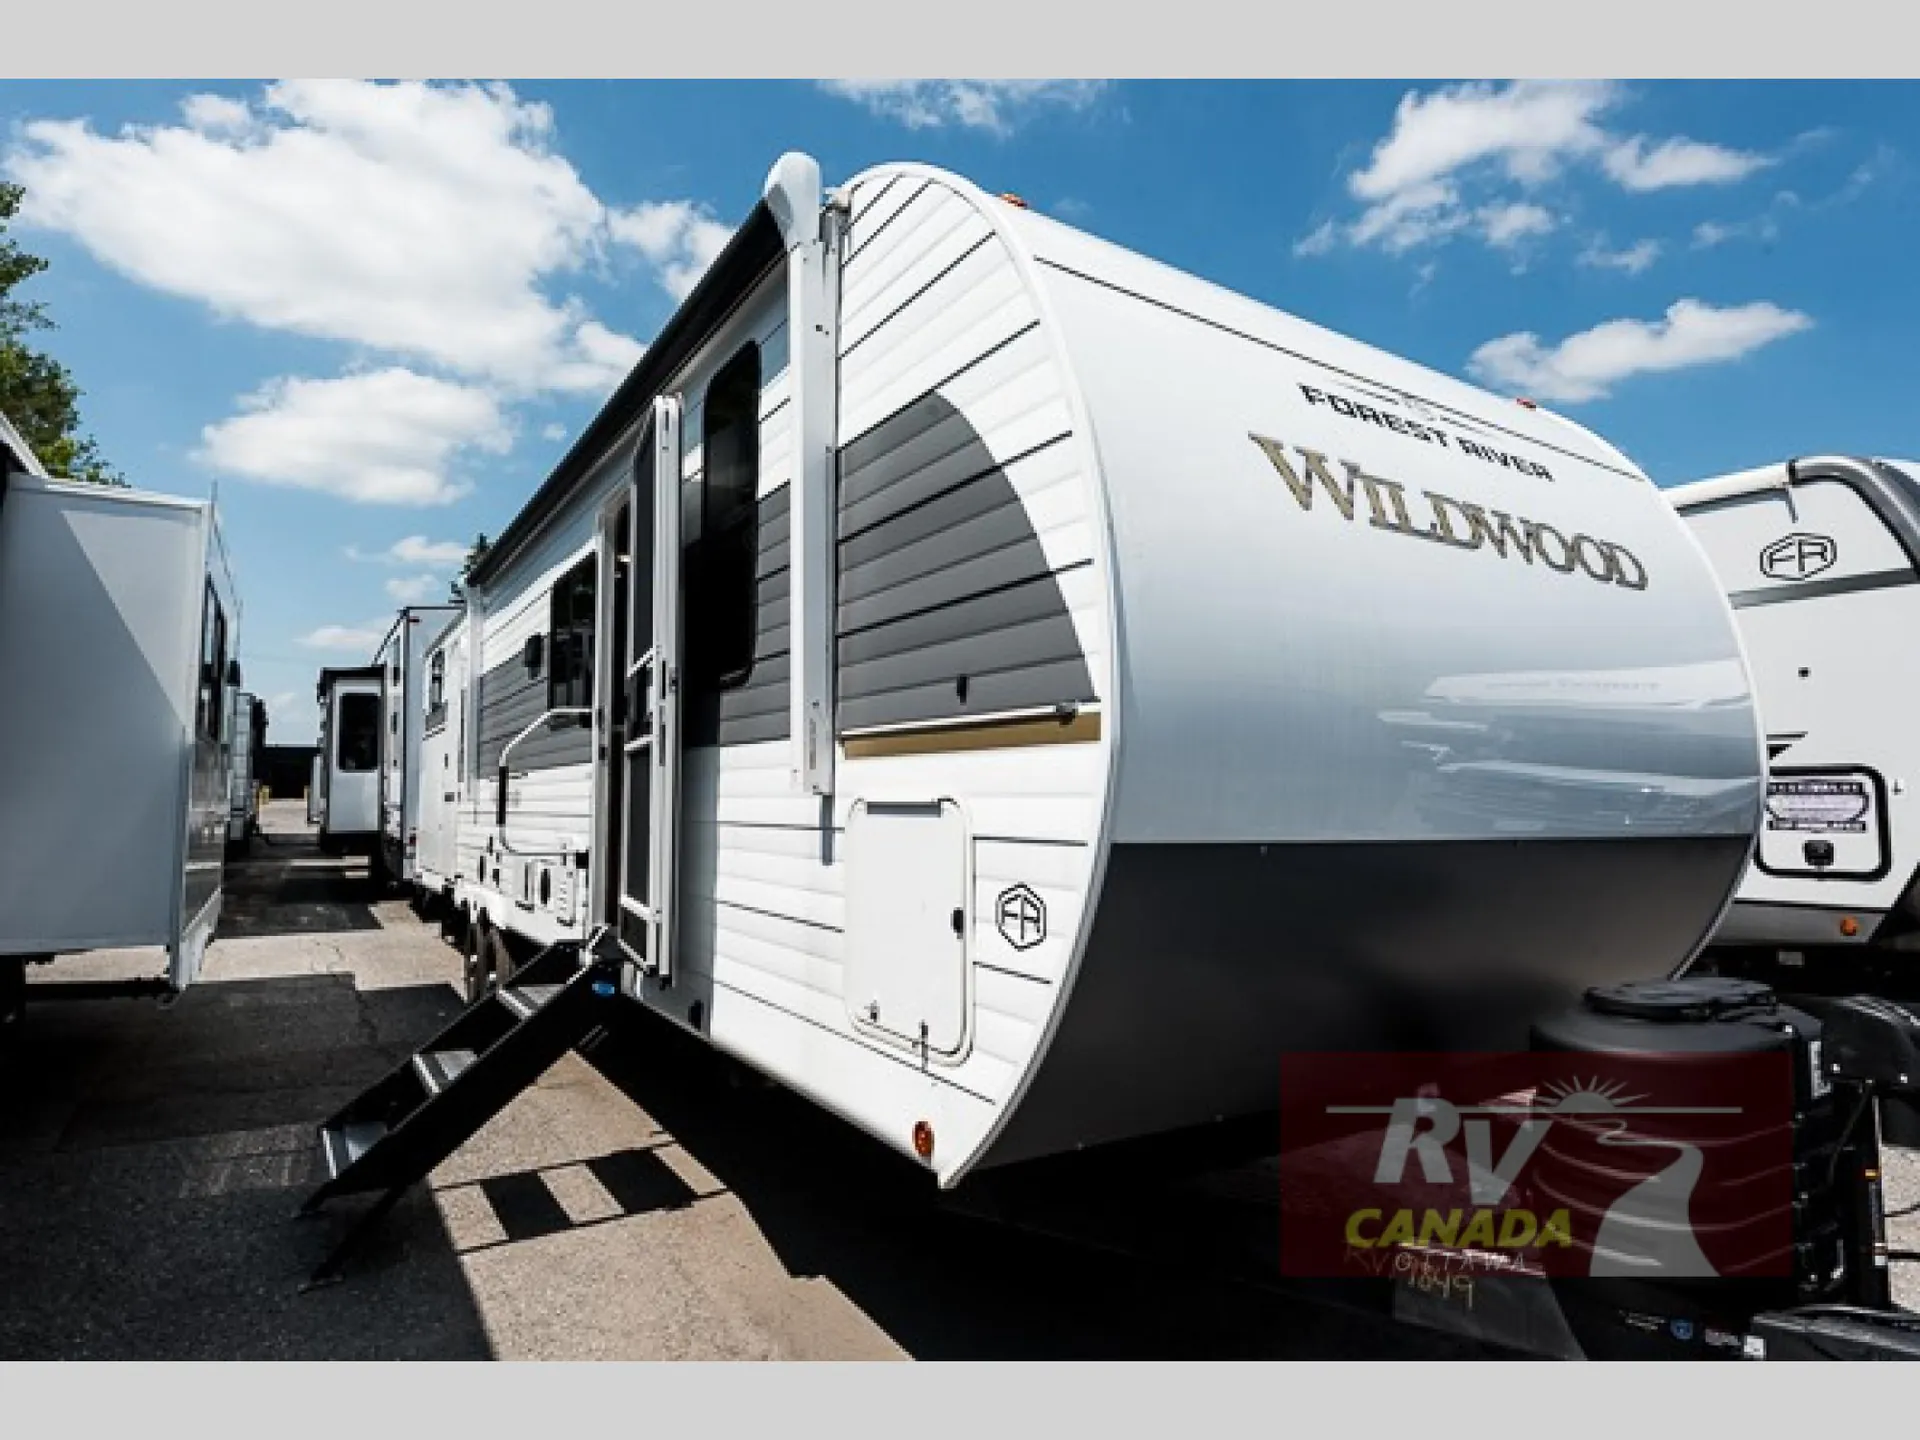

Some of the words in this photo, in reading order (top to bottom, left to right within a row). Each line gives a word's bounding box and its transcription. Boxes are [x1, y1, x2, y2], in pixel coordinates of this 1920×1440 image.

[1297, 383, 1449, 447] FOREST
[1456, 436, 1555, 482] RIVER
[1248, 431, 1648, 590] WILDWOOD
[1765, 537, 1829, 573] FR
